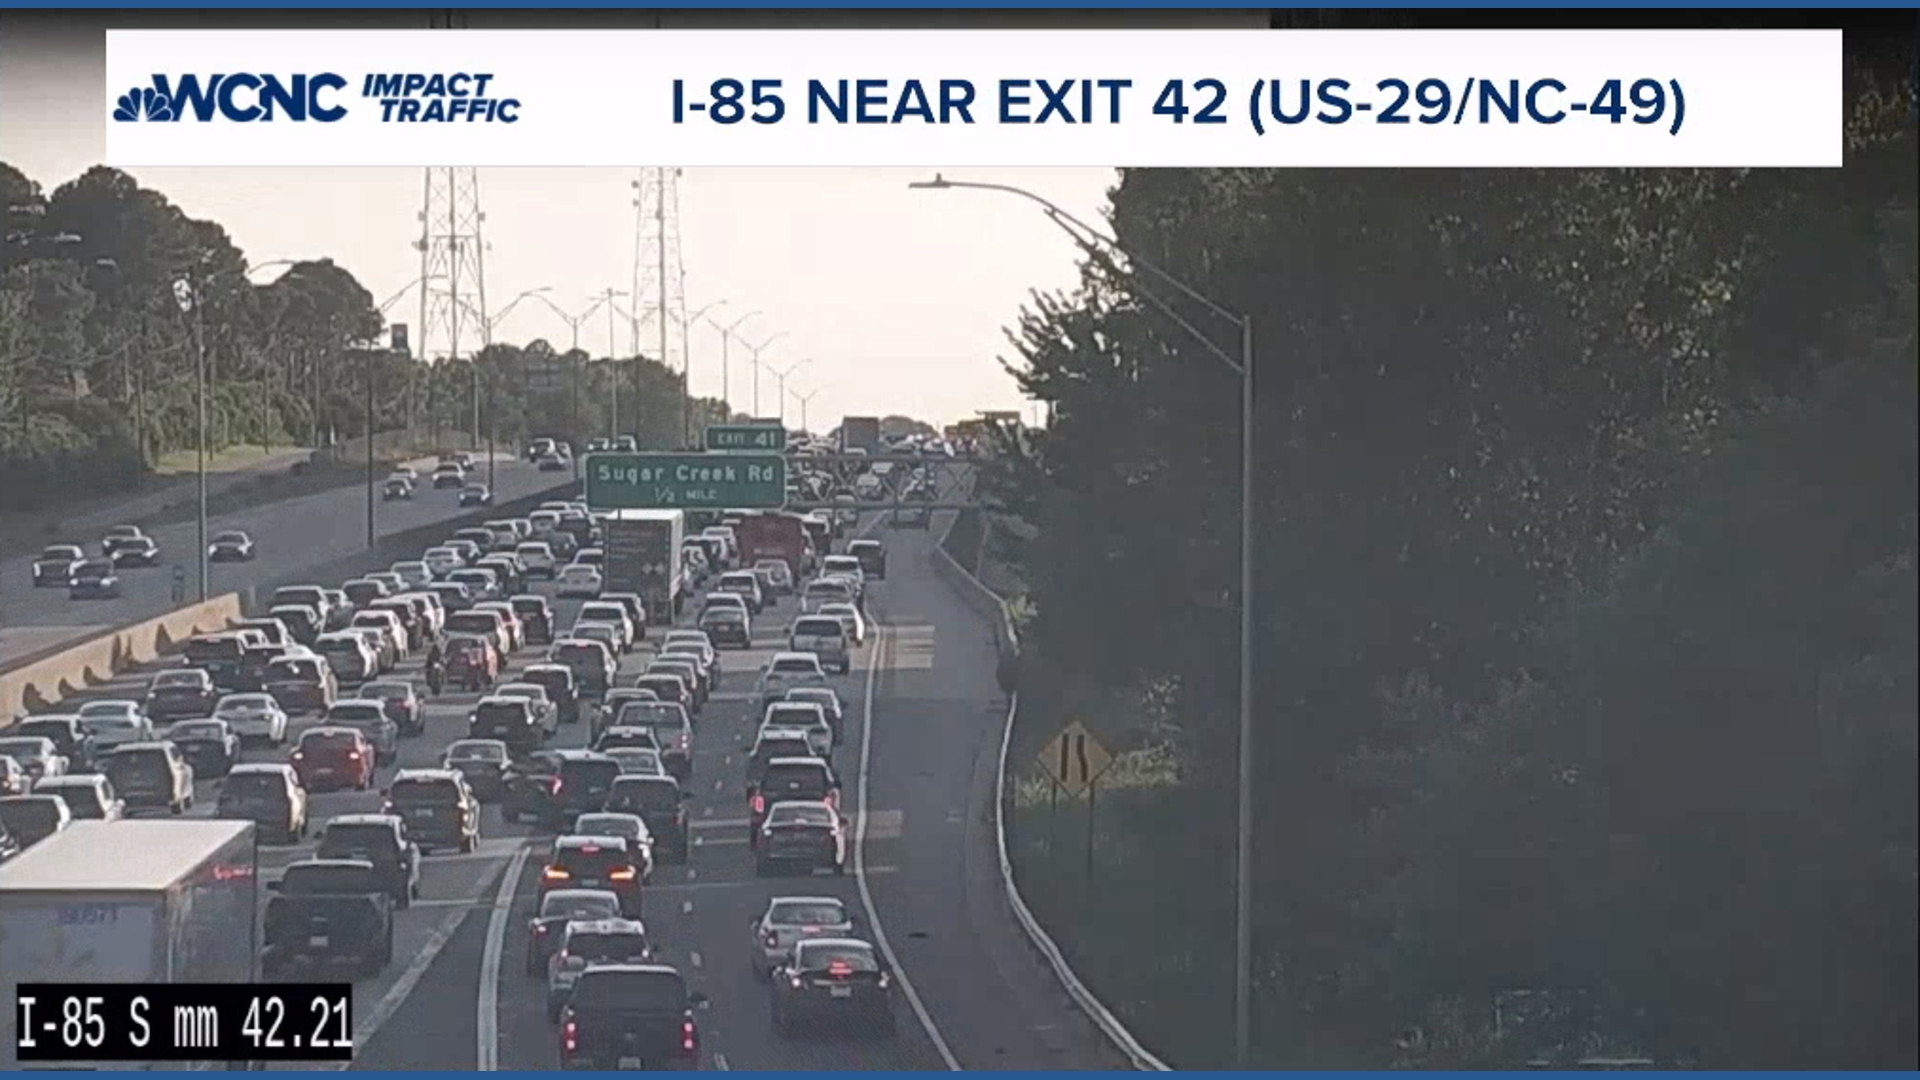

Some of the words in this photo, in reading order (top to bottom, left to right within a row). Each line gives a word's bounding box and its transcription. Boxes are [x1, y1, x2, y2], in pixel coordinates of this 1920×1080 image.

[754, 431, 776, 447] 41
[598, 464, 664, 484] Sugar
[675, 464, 736, 482] Creek
[748, 464, 774, 482] Rd
[685, 488, 717, 500] MILE
